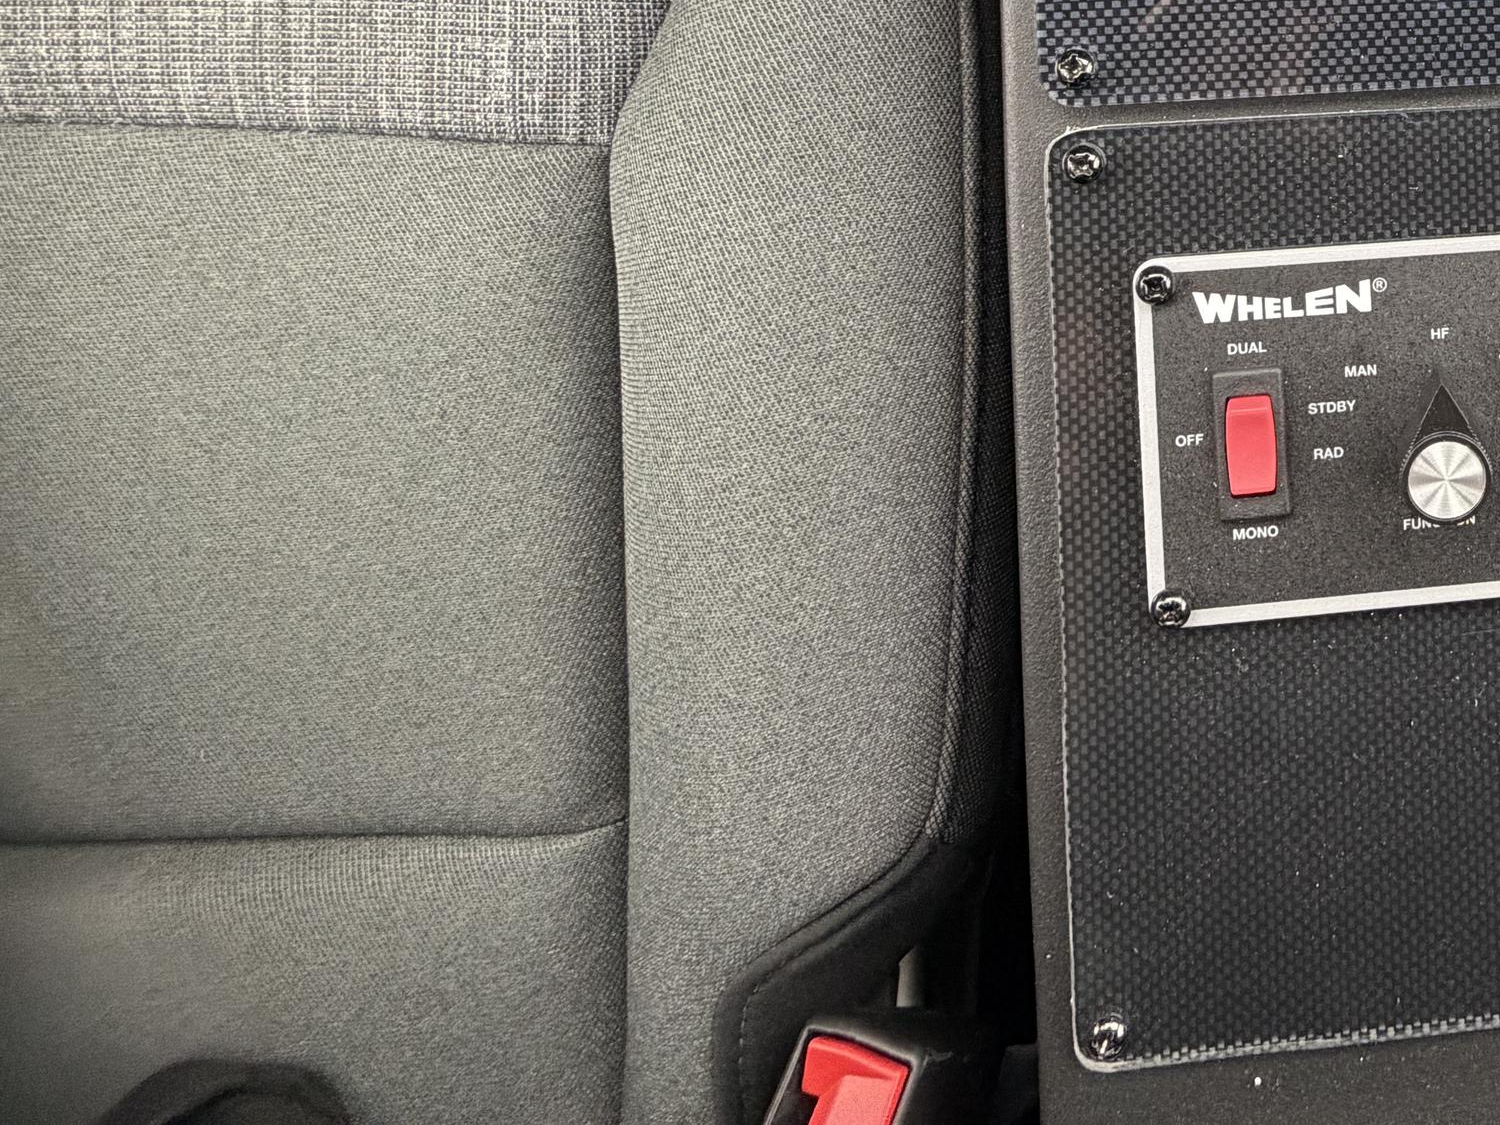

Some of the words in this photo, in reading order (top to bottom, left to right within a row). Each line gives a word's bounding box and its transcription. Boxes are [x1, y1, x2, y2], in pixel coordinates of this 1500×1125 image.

[1430, 326, 1451, 341] HF
[1226, 341, 1267, 356] DUAL
[1343, 363, 1378, 378] MAN
[1307, 400, 1356, 415] STDBY
[1174, 433, 1204, 448] OFF
[1313, 446, 1345, 461] RAD
[1232, 524, 1280, 541] MONO
